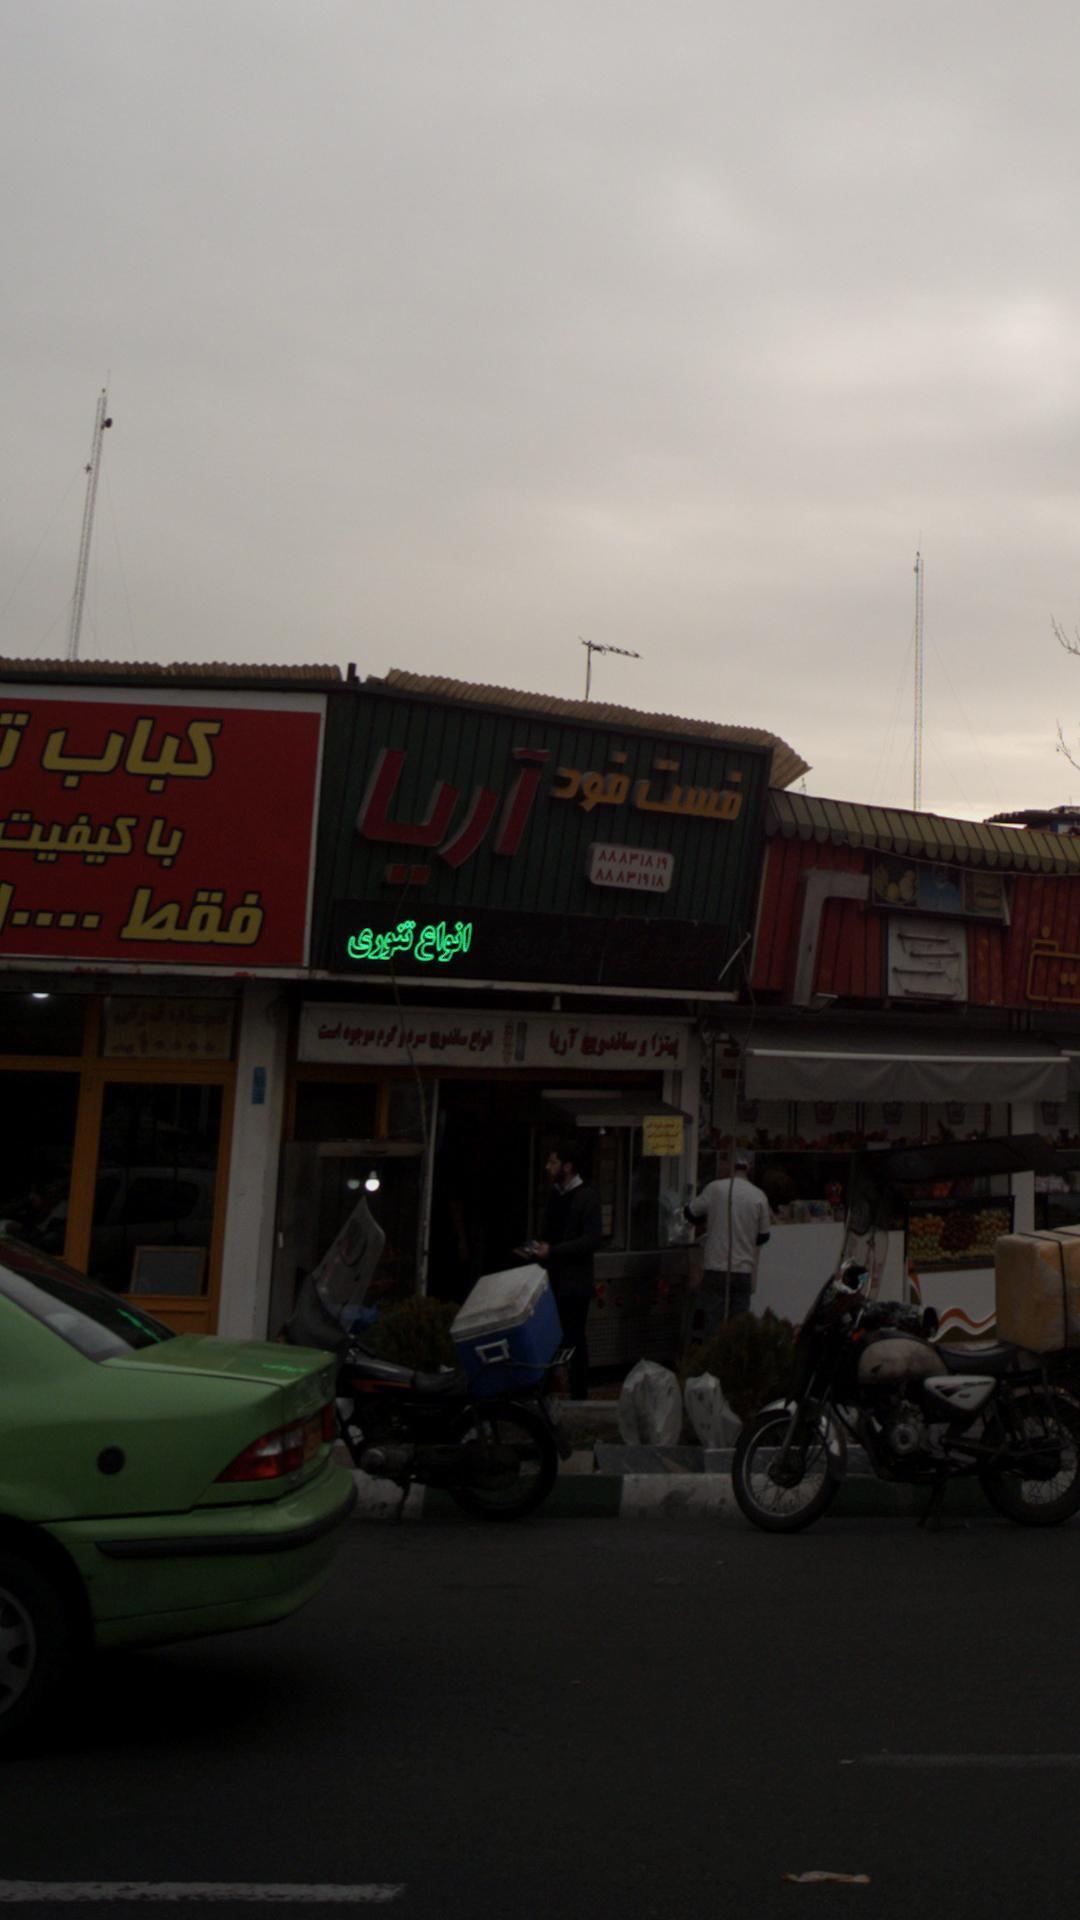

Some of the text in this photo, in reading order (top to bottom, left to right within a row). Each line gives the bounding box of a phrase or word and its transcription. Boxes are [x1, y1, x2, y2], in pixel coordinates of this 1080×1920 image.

[41, 716, 223, 793] کباب
[550, 750, 746, 823] فست فود
[355, 745, 553, 887] آریا
[0, 810, 185, 869] با کیفیت
[119, 886, 265, 947] فقط
[346, 919, 416, 961] تنوری
[414, 919, 474, 963] انواع
[469, 1027, 494, 1052] انواع
[548, 1027, 579, 1057] آریا
[580, 1031, 638, 1057] ساندویچ
[651, 1032, 680, 1060] پیتزا
